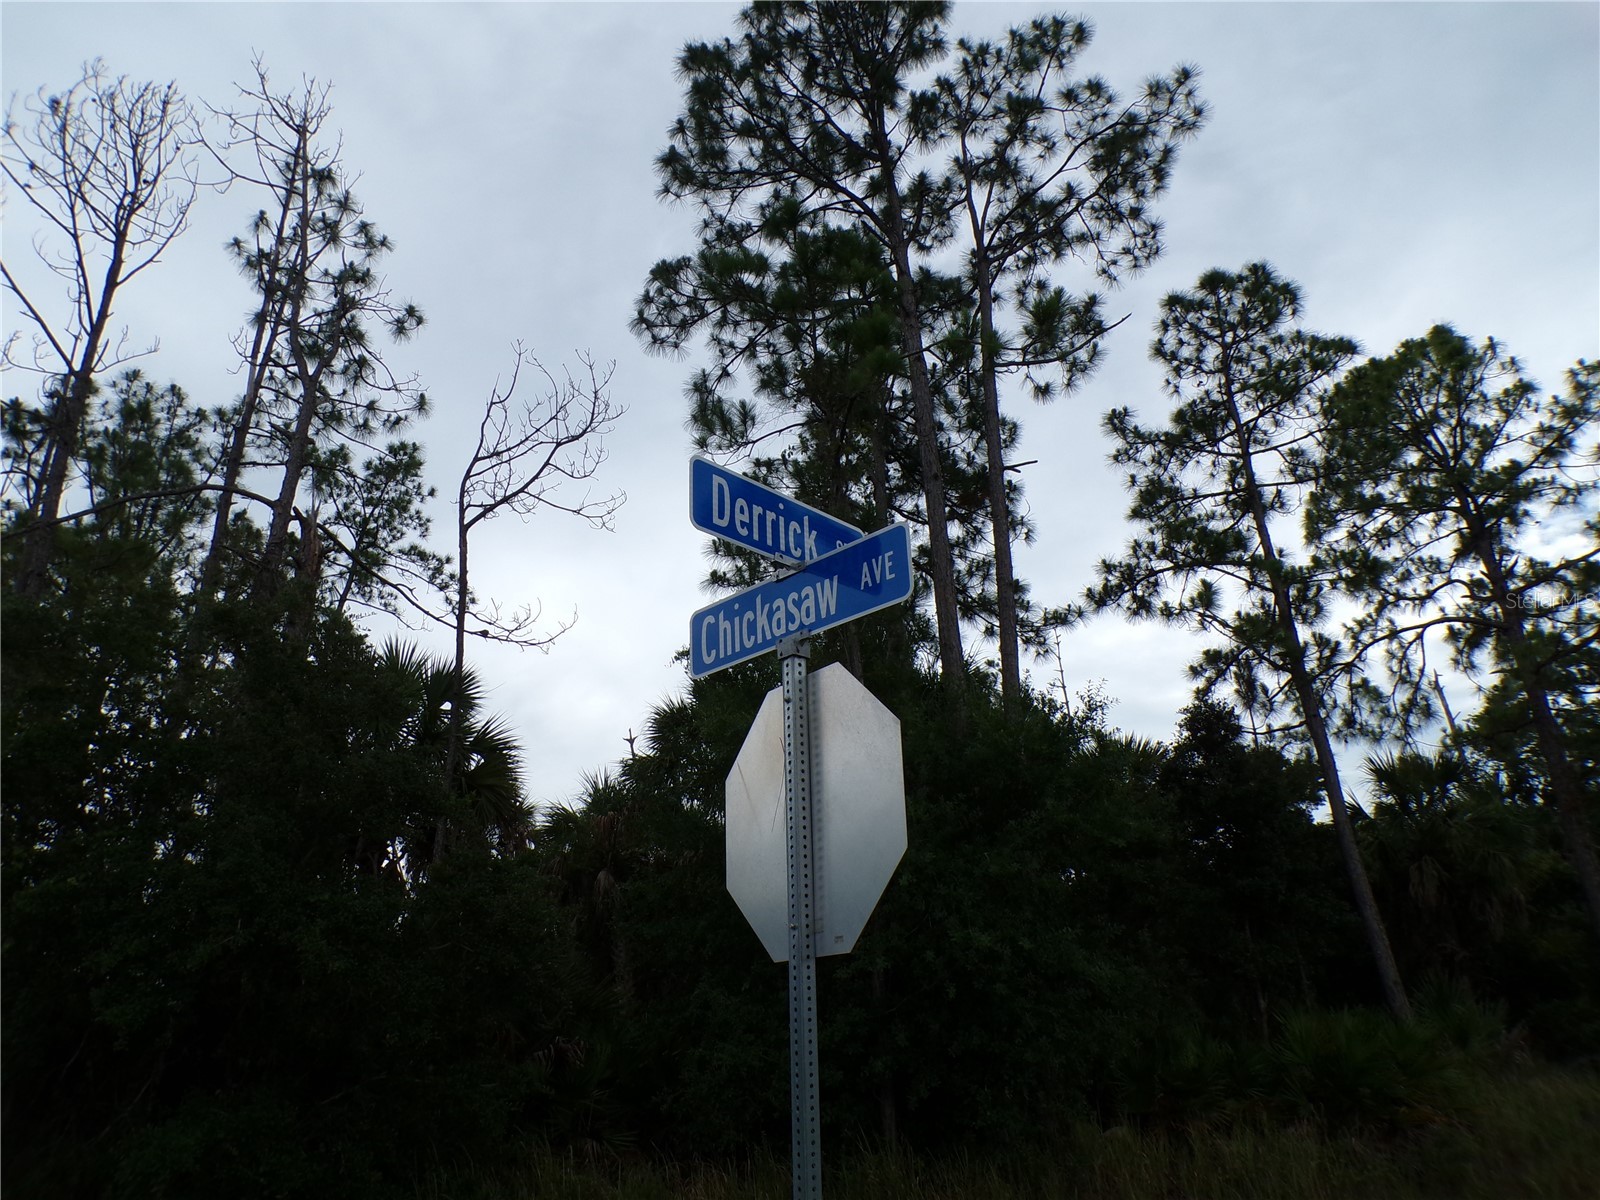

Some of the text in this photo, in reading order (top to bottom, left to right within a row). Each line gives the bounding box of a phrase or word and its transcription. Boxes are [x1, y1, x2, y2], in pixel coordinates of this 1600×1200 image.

[712, 474, 817, 561] Derrick
[701, 550, 895, 665] Chickasaw AVE
